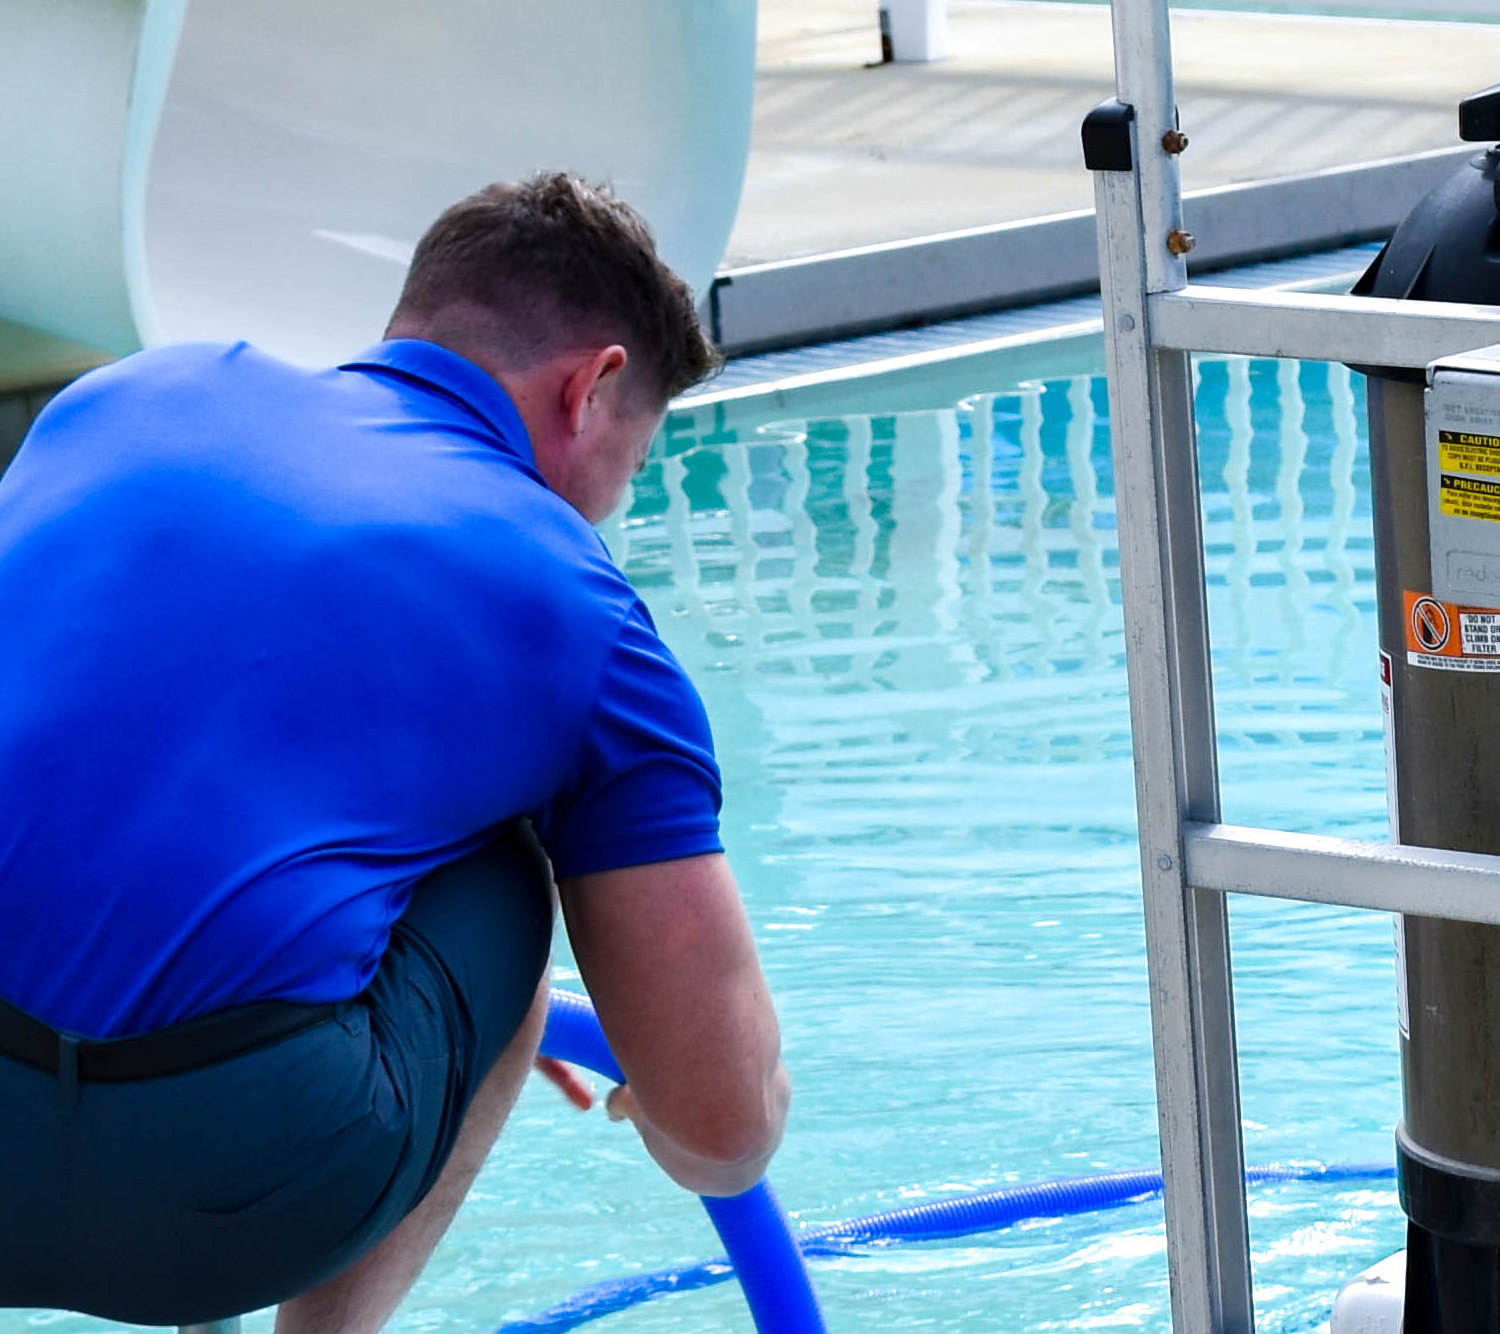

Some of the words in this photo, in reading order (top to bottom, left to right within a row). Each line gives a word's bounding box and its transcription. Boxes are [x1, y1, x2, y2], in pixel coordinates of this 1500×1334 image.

[1468, 614, 1479, 624] DO
[1480, 615, 1496, 624] NOT
[1464, 624, 1488, 634] STAND
[1465, 634, 1489, 643] CLIMB
[1472, 644, 1497, 653] FILTER
